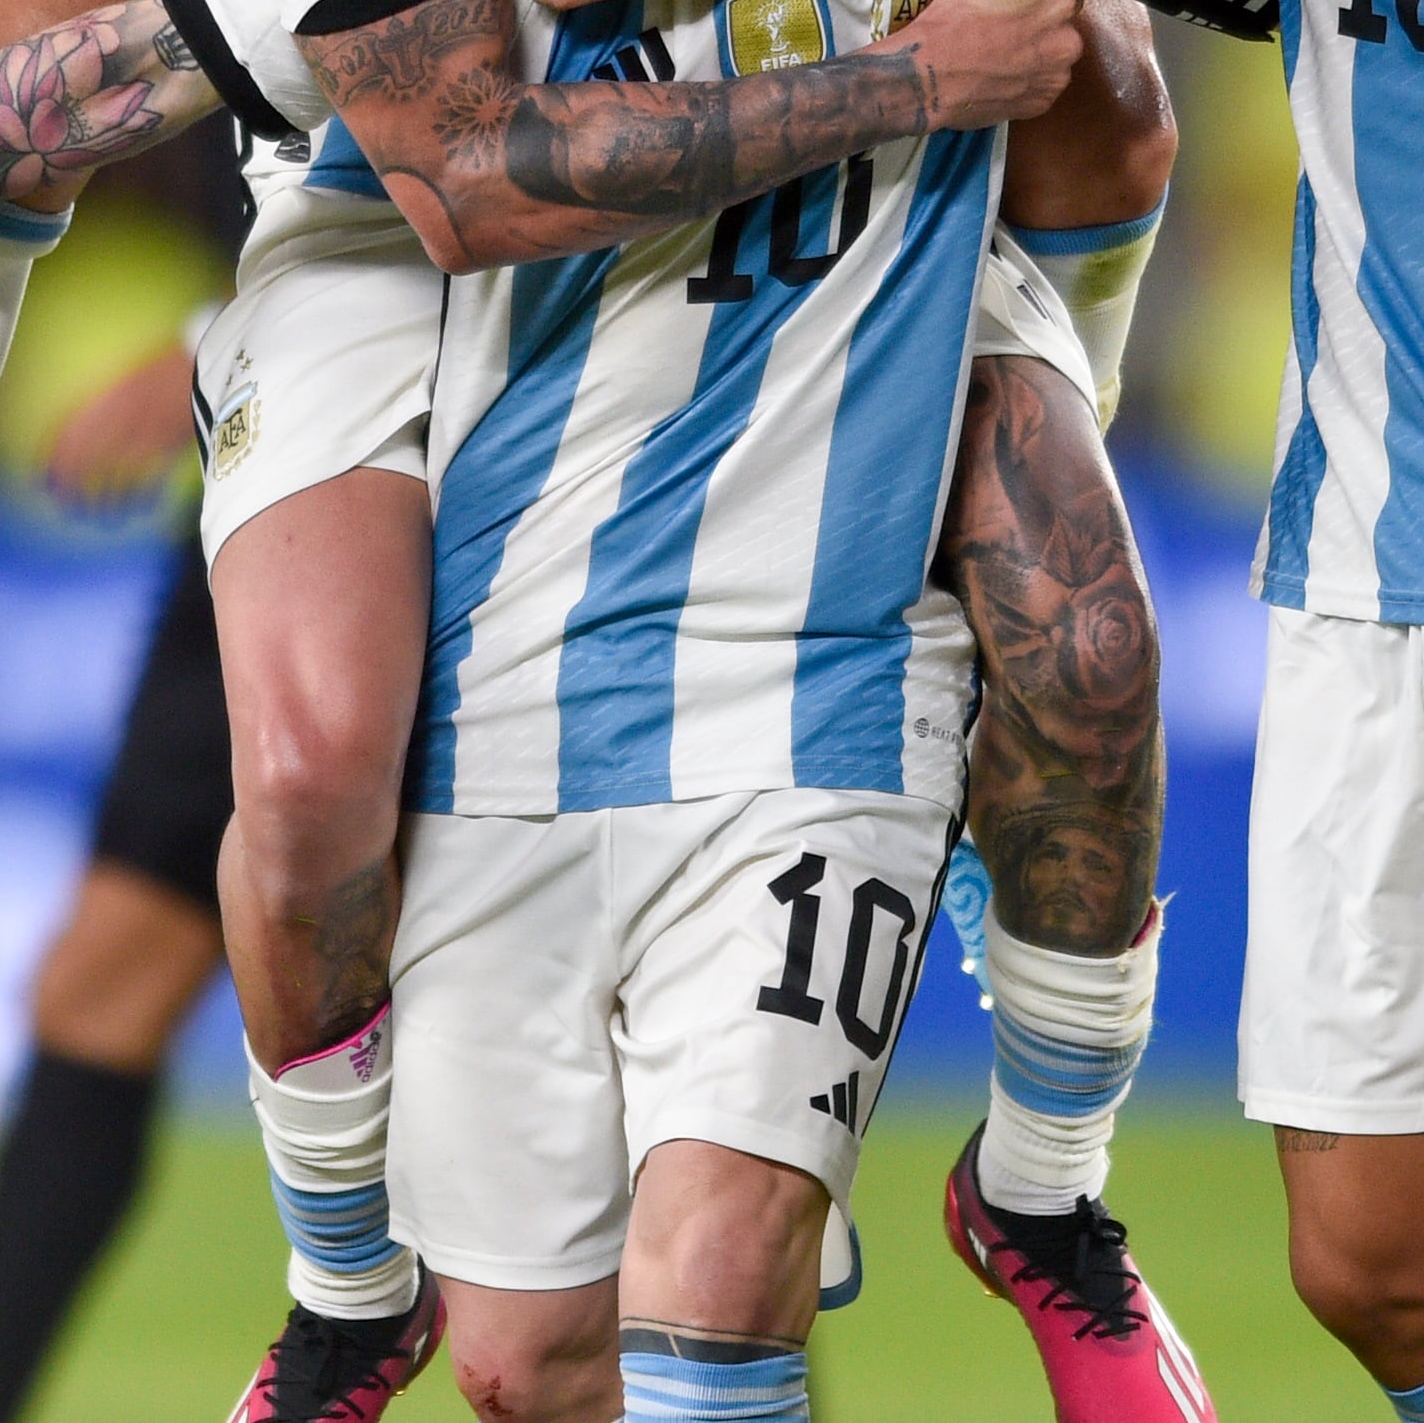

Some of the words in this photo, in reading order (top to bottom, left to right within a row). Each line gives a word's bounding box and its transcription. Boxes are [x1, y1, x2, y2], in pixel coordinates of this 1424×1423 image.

[761, 54, 802, 72] FIFA
[218, 407, 246, 455] AFA
[756, 852, 915, 1060] 10
